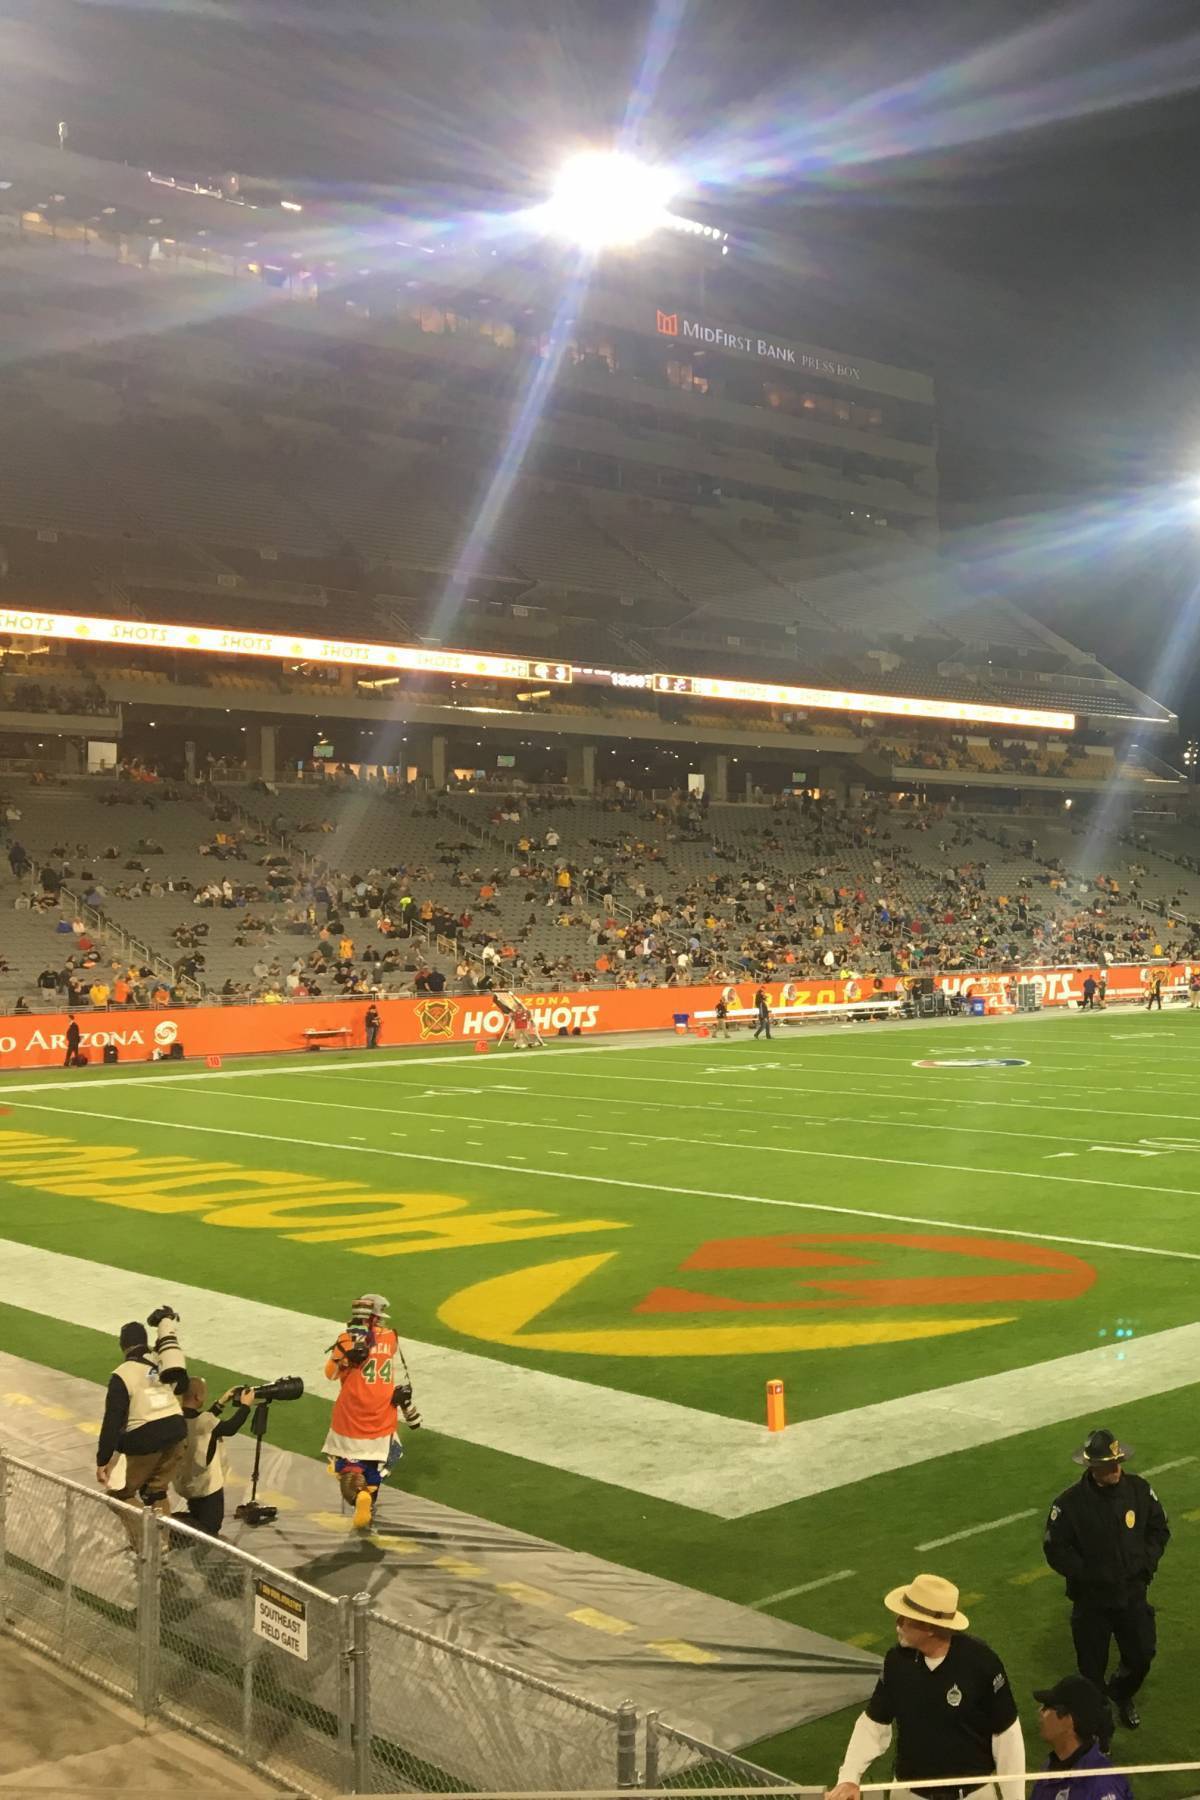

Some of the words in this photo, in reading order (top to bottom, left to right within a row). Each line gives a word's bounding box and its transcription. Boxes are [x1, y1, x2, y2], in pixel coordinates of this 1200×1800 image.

[462, 1005, 600, 1035] HOHOTS
[25, 1029, 145, 1051] ARZONA
[362, 1358, 393, 1385] 44
[260, 1602, 301, 1634] SOUTHEAST
[261, 1620, 280, 1641] FIELD
[281, 1632, 300, 1652] GATE
